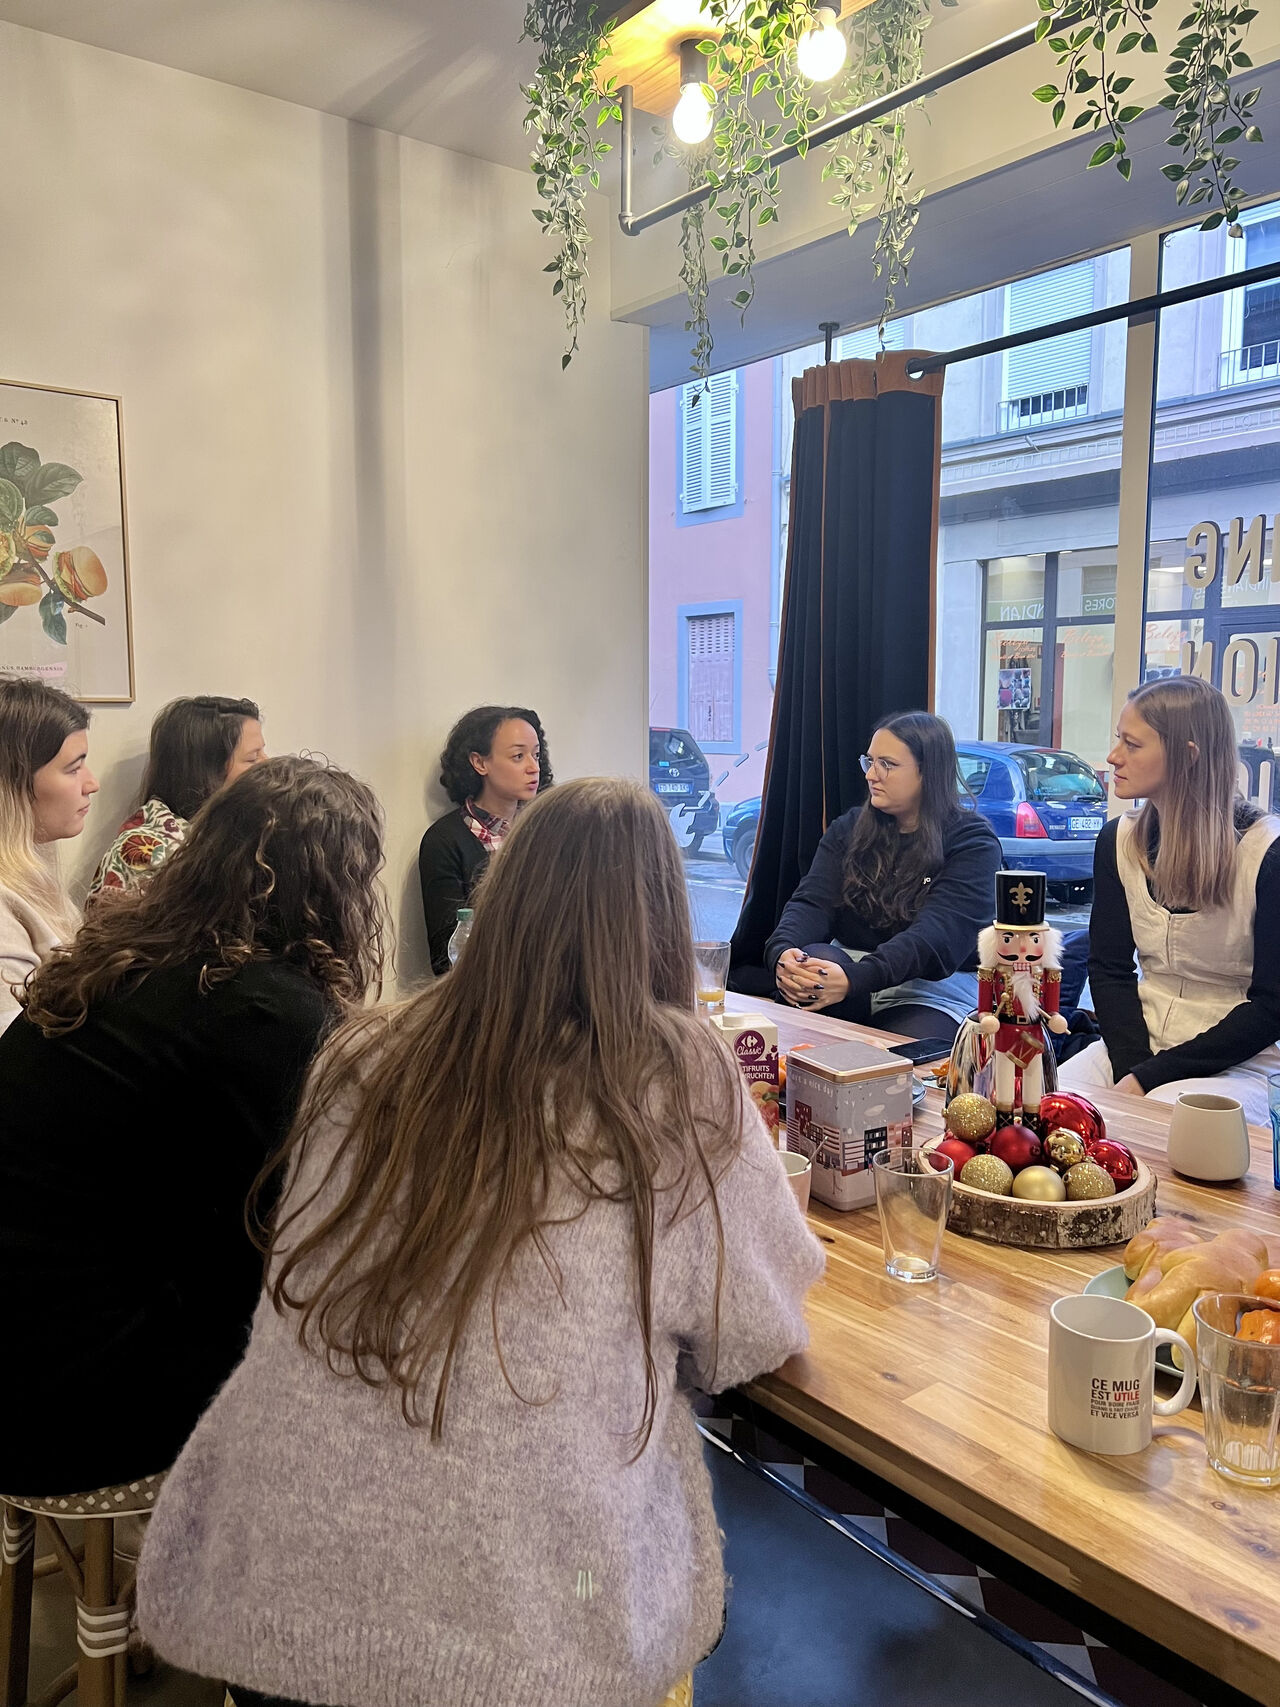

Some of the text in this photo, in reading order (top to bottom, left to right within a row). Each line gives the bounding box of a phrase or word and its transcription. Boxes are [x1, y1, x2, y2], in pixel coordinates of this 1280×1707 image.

[736, 1045, 763, 1056] Classic
[823, 1083, 834, 1098] day
[1091, 1378, 1140, 1392] CE MUG
[1091, 1389, 1140, 1402] EST UTILE
[1090, 1409, 1139, 1419] ET VICE VERSA
